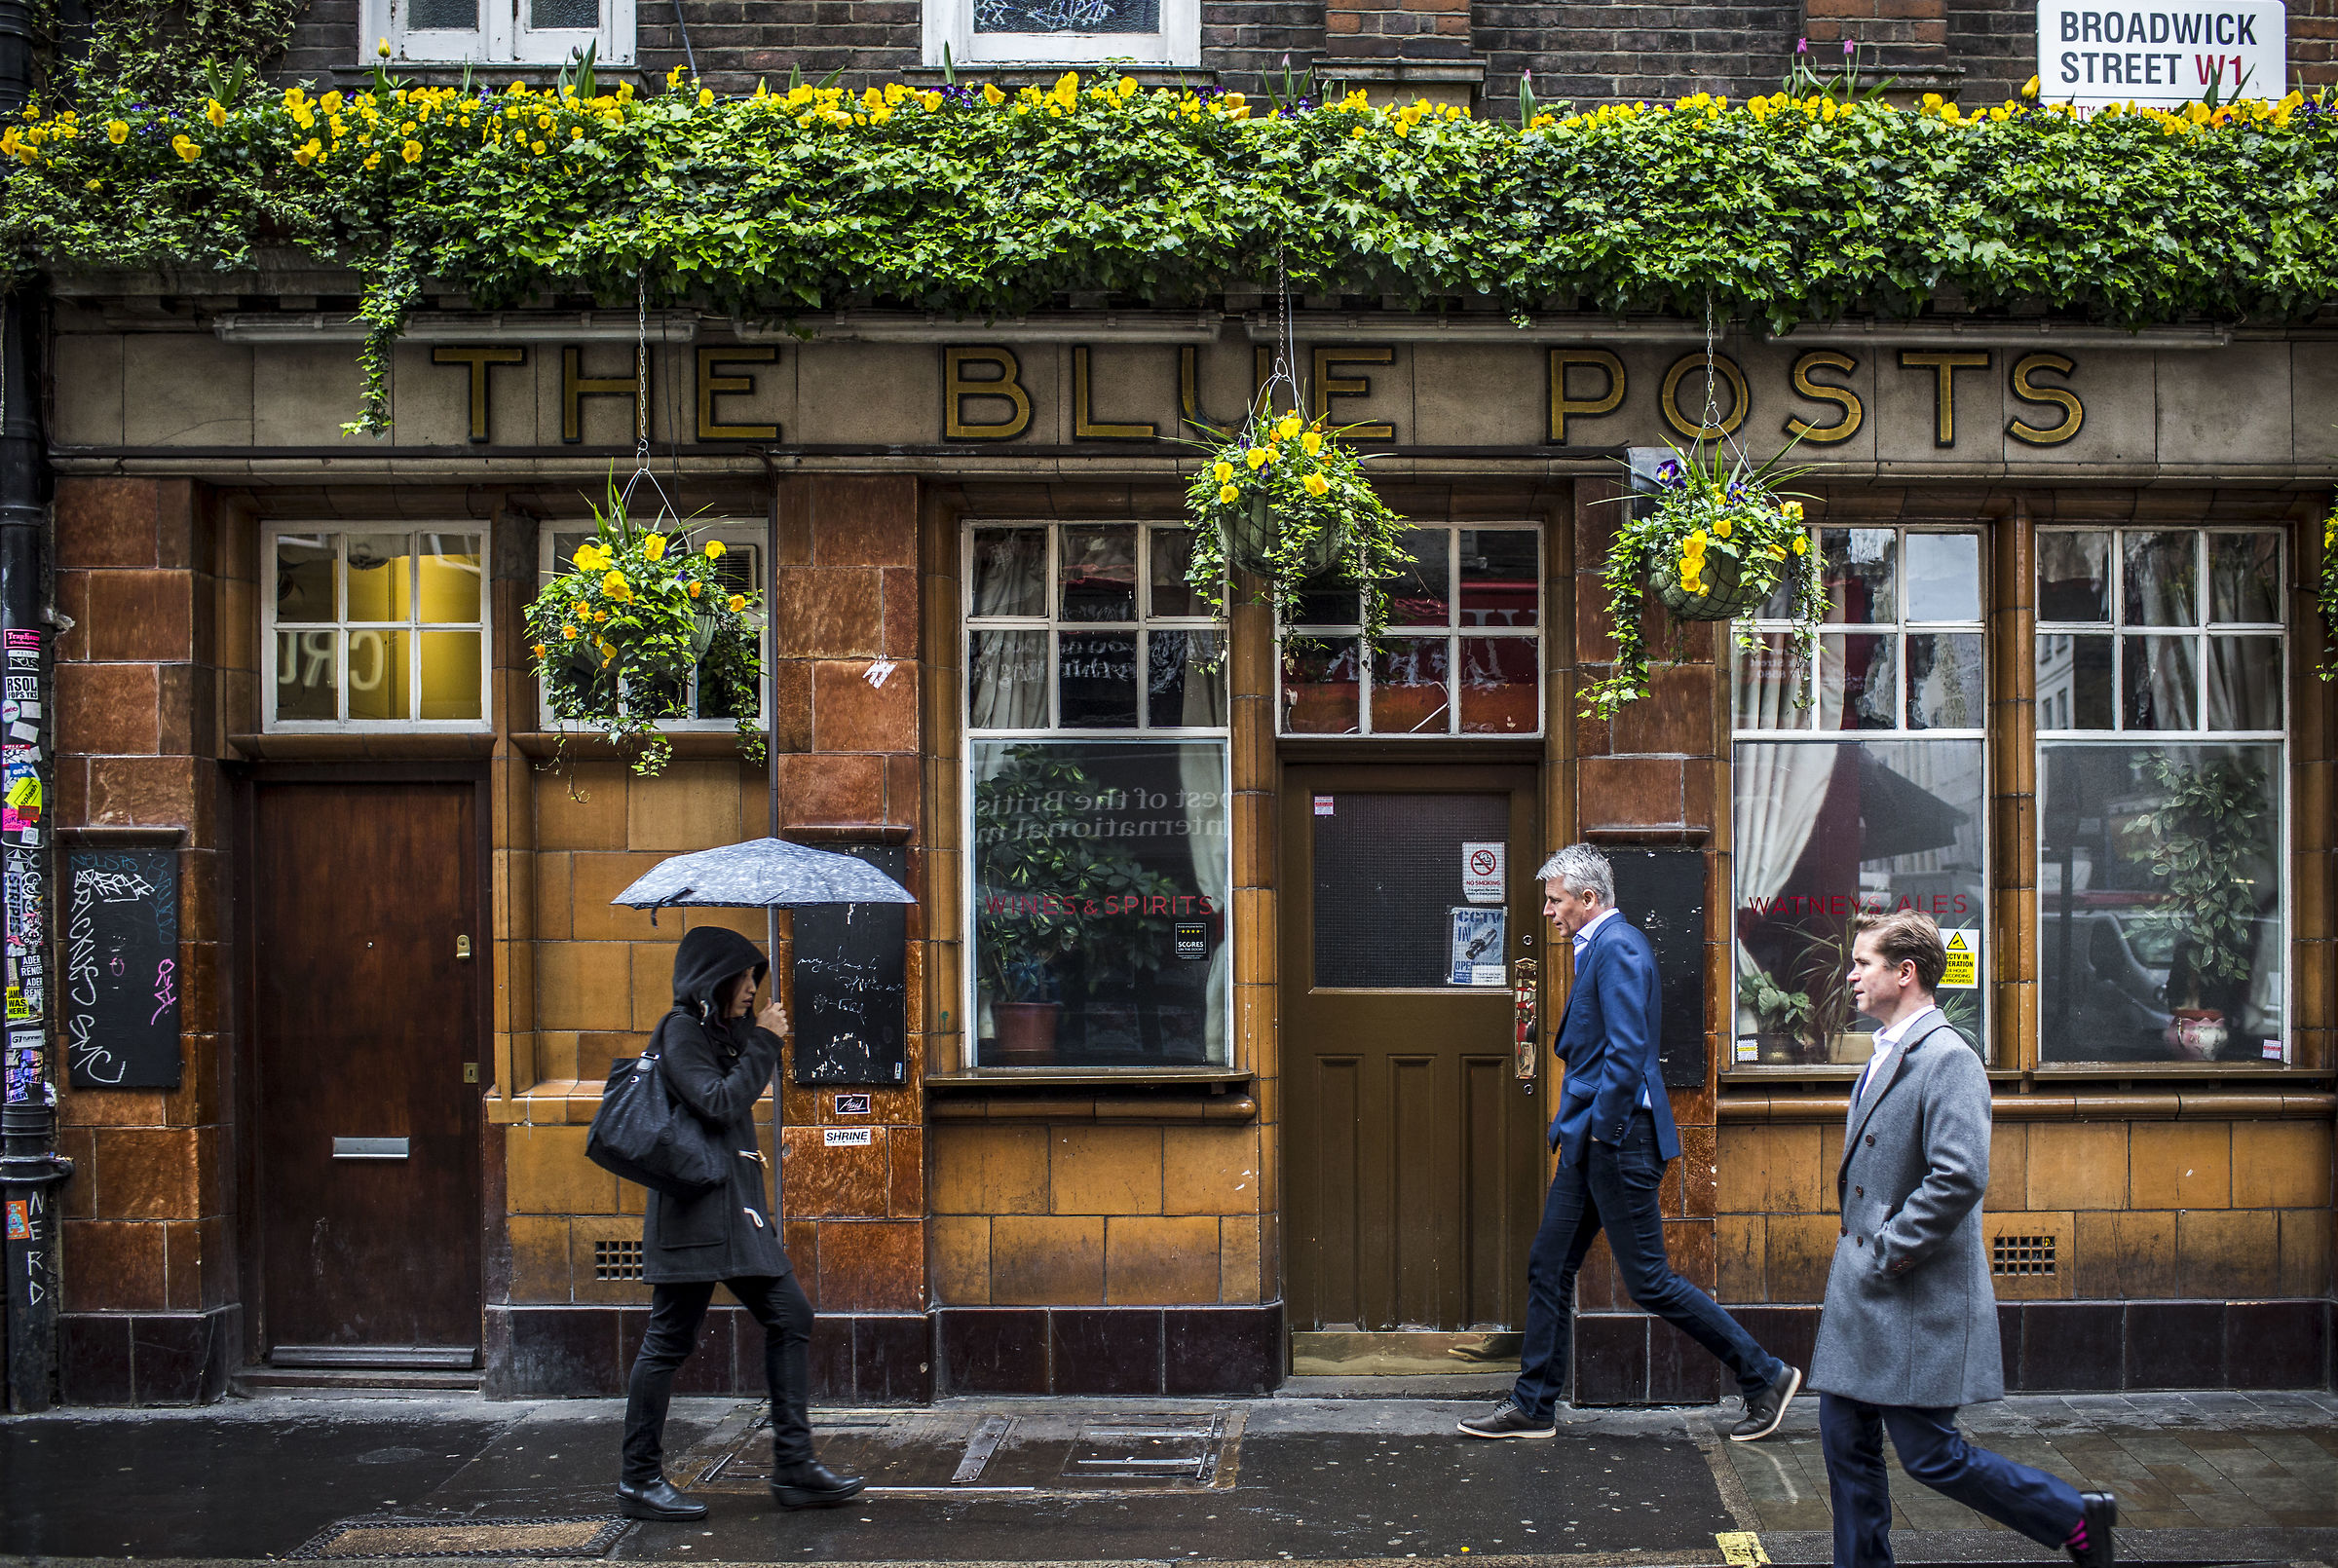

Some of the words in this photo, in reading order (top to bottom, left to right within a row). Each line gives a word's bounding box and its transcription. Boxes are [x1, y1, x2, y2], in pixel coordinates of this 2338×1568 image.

[2060, 11, 2257, 45] BROADWICK
[2060, 52, 2182, 85] STREET
[2195, 54, 2242, 86] W1
[432, 345, 781, 443] THE
[943, 345, 1395, 443] BLUE
[1545, 347, 2087, 447] POSTS
[7, 677, 37, 691] RSOL
[8, 875, 20, 933] STRIPES
[984, 895, 1076, 915] WINES
[1083, 898, 1099, 915] &
[1105, 895, 1214, 915] SPIRITS
[1749, 896, 1881, 915] WATNEYS
[1897, 894, 1968, 914] ALES
[1457, 911, 1502, 923] CCTV
[1457, 926, 1472, 942] IN
[826, 1131, 869, 1141] SHRINE
